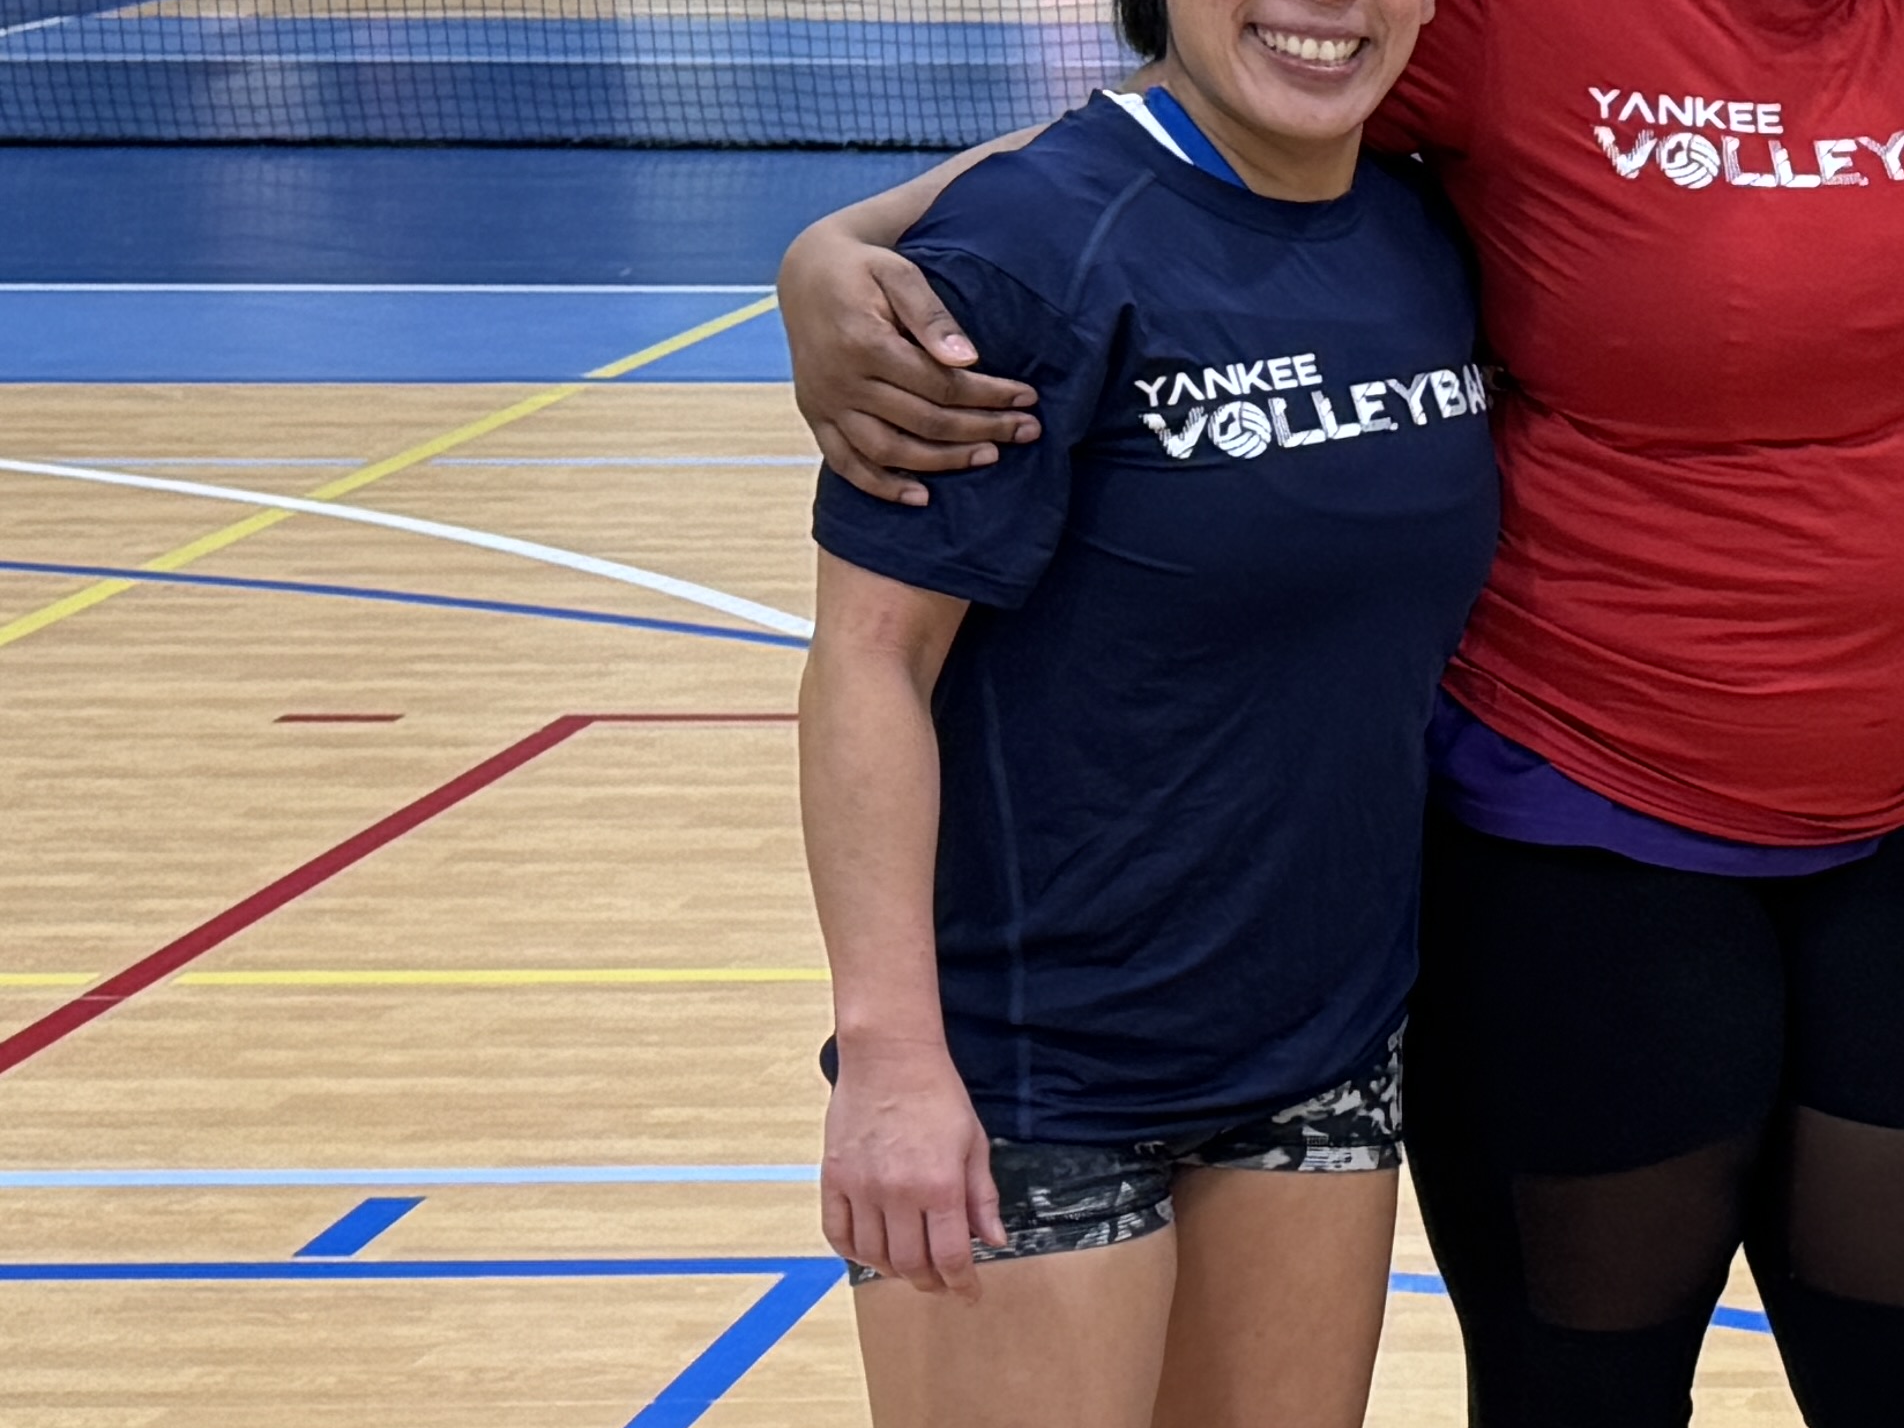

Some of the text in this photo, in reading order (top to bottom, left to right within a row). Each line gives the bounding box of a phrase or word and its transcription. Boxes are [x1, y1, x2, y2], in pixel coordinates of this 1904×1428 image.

[1587, 86, 1784, 135] YANKEE
[1133, 352, 1324, 409] YANKEE
[1137, 363, 1488, 460] VOLLEYBA
